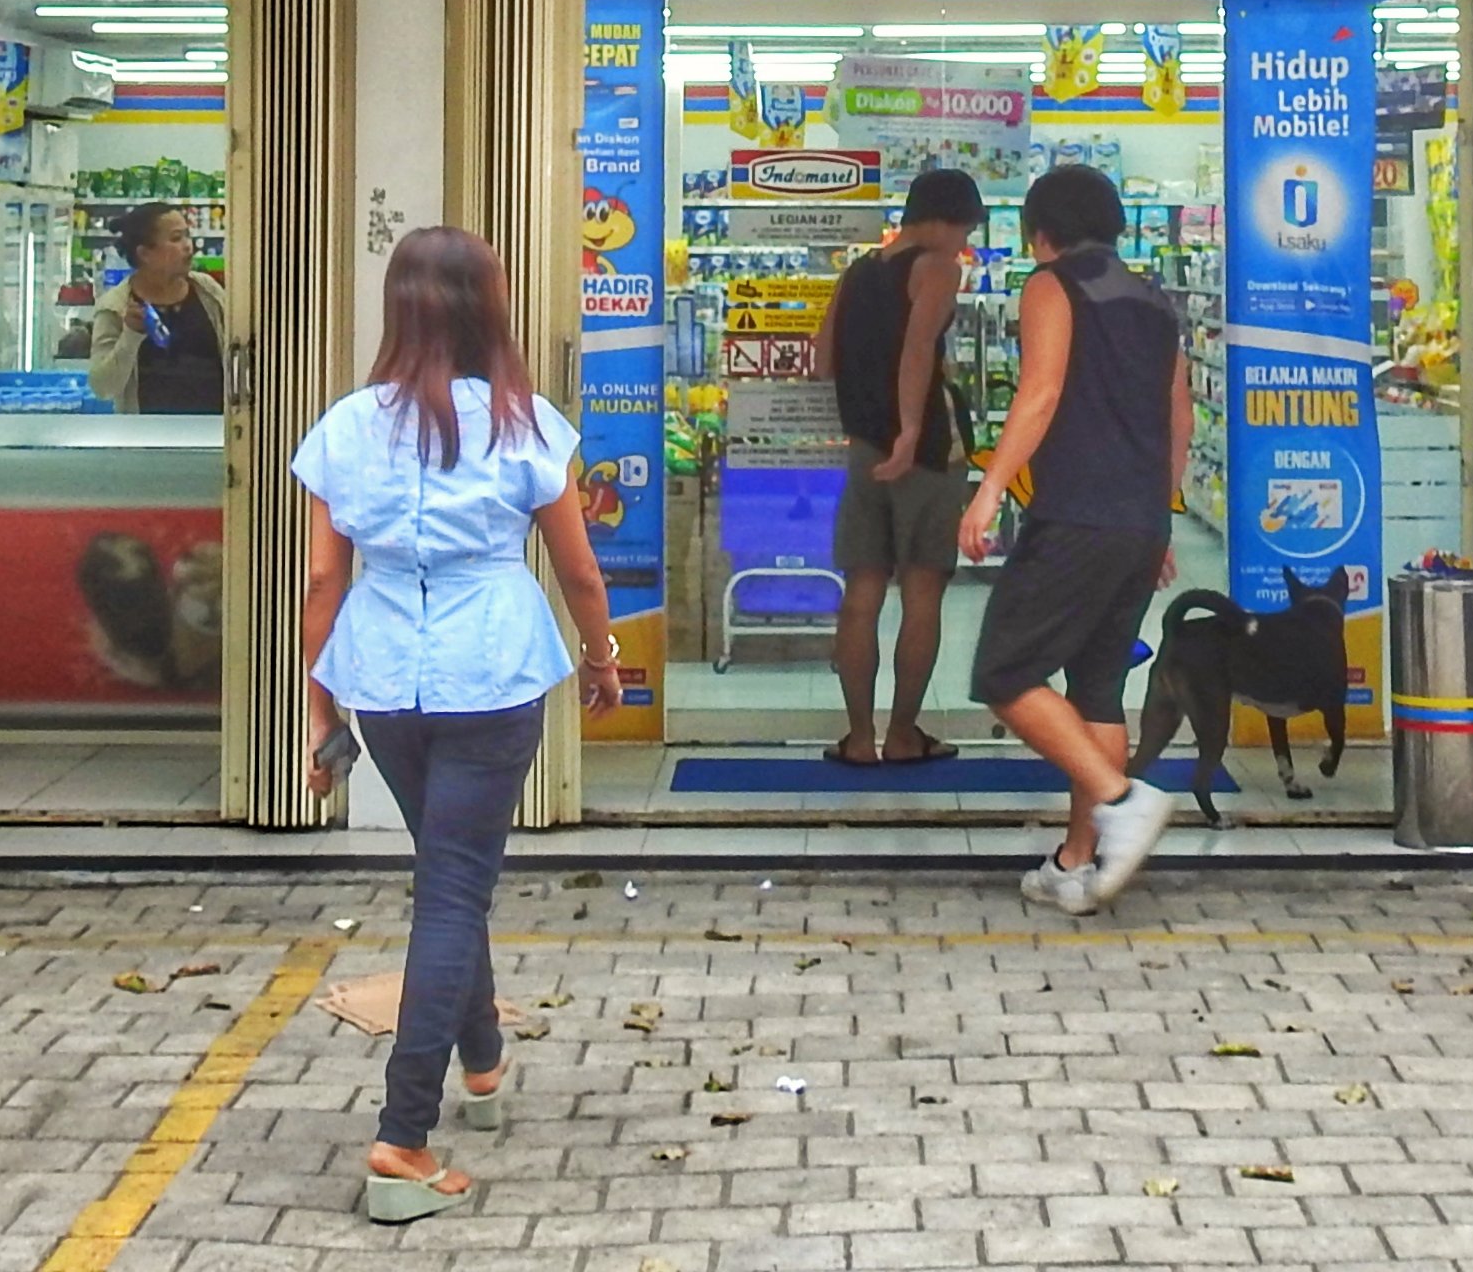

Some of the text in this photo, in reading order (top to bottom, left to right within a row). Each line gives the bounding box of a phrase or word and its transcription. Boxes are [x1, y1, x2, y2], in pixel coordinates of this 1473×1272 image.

[1250, 49, 1350, 86] Hidup
[1278, 87, 1348, 113] Lebih
[1252, 113, 1349, 139] Mobile!
[586, 157, 640, 173] Brand
[758, 161, 854, 185] Indomaret
[583, 278, 649, 296] HADIR
[585, 297, 648, 313] DEKAT
[1245, 366, 1358, 386] BELANJA MAKIN
[602, 382, 659, 396] ONLINE
[590, 398, 659, 414] MUDAH
[1245, 389, 1359, 427] UNTUNG
[1274, 450, 1331, 470] DENGAN
